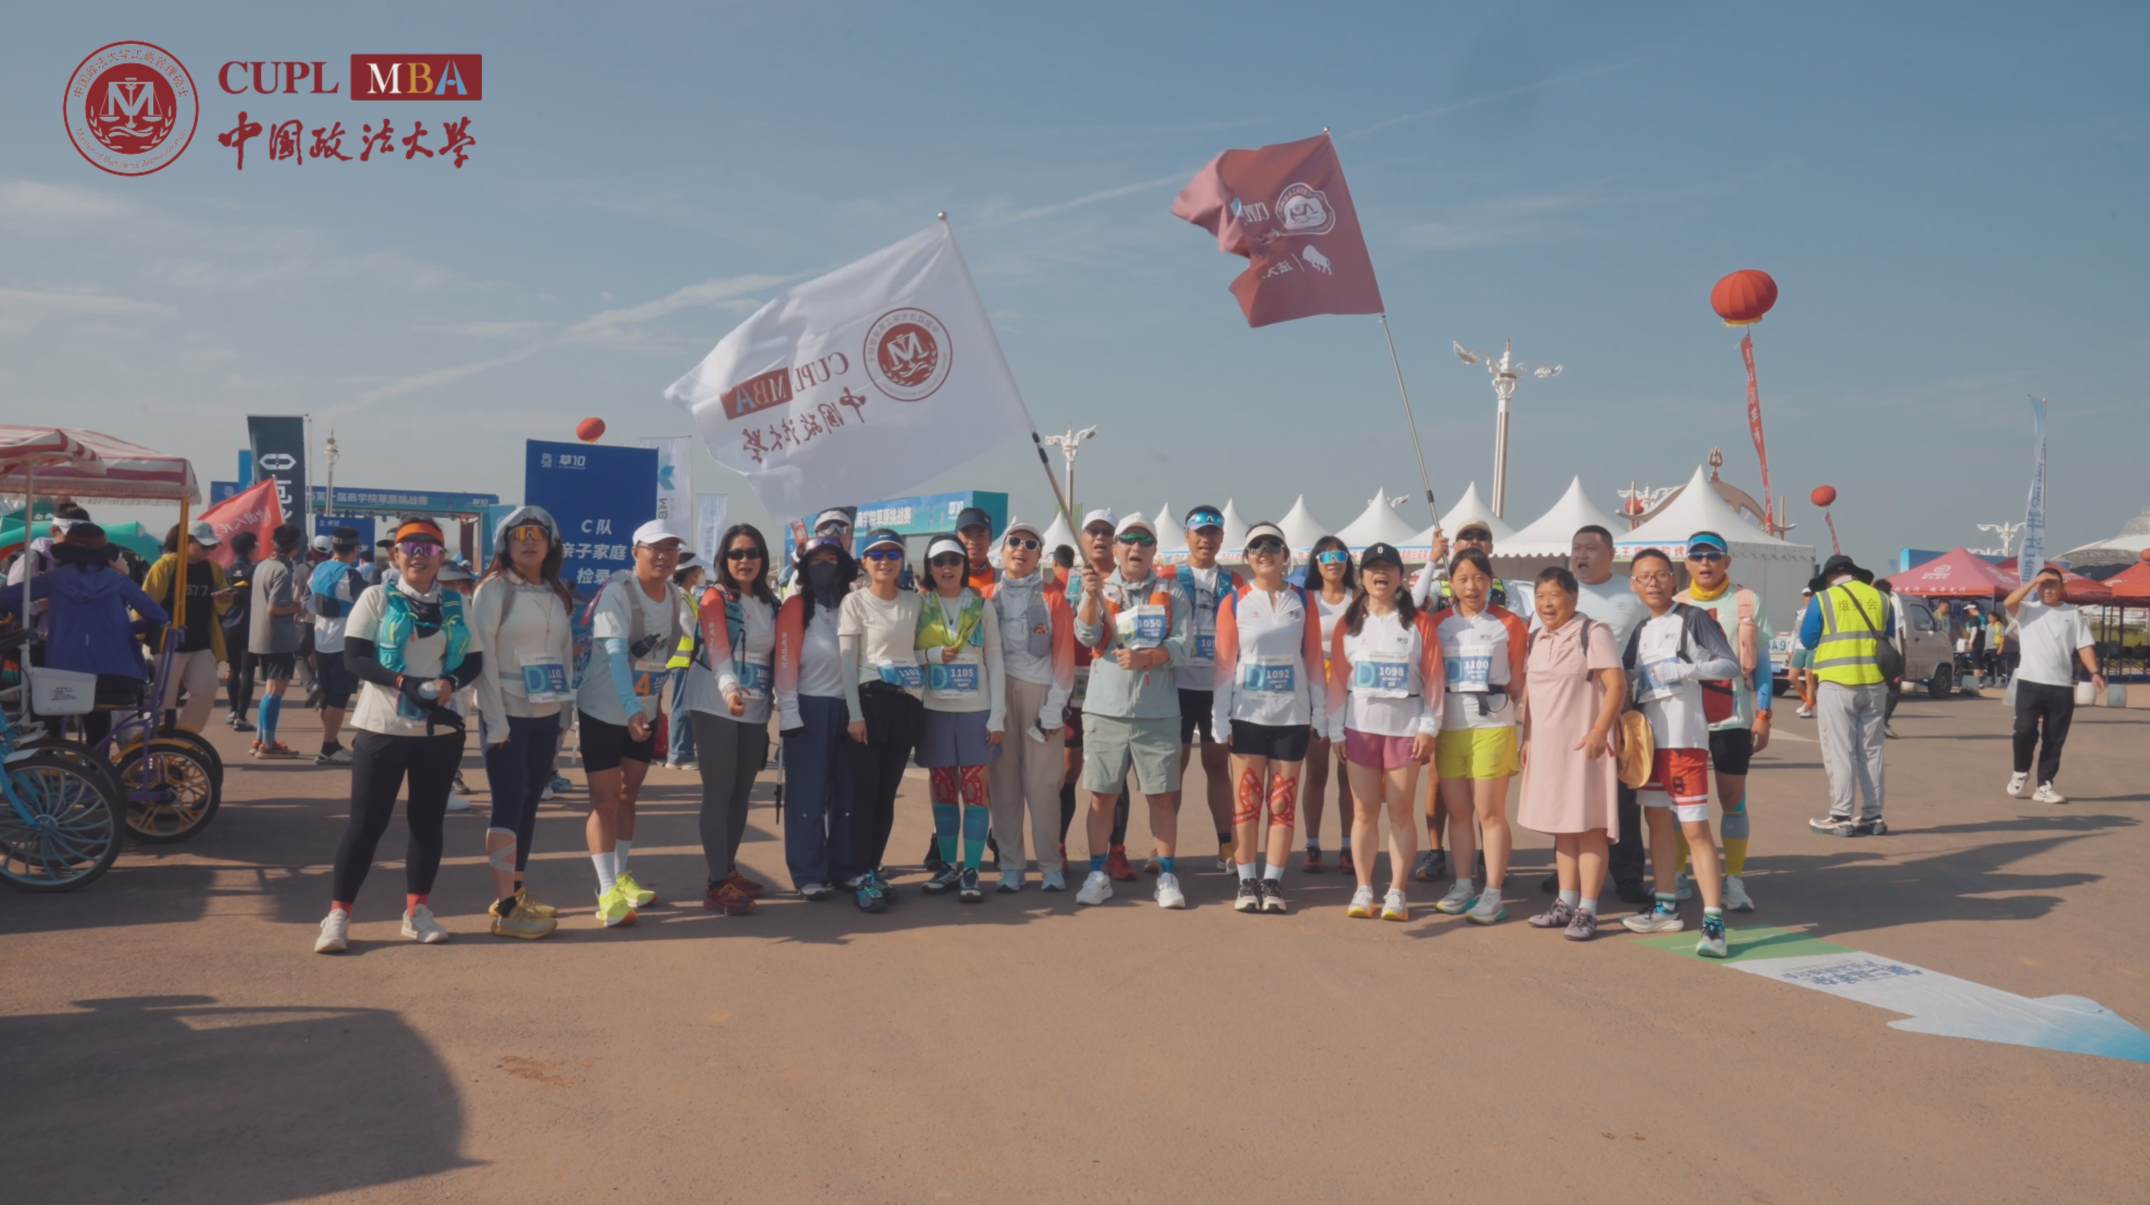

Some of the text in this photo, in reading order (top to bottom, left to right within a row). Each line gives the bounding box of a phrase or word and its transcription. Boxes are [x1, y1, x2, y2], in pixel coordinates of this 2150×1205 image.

[581, 519, 613, 535] C 队
[563, 542, 627, 560] 亲子家庭
[1138, 618, 1162, 628] 1050
[950, 668, 974, 678] 1105
[1379, 667, 1404, 677] 1098
[1464, 660, 1489, 670] 1100
[524, 665, 546, 694] D
[930, 664, 948, 690] D
[1244, 663, 1265, 691] D
[1266, 670, 1290, 680] 1092
[1355, 661, 1376, 688] D
